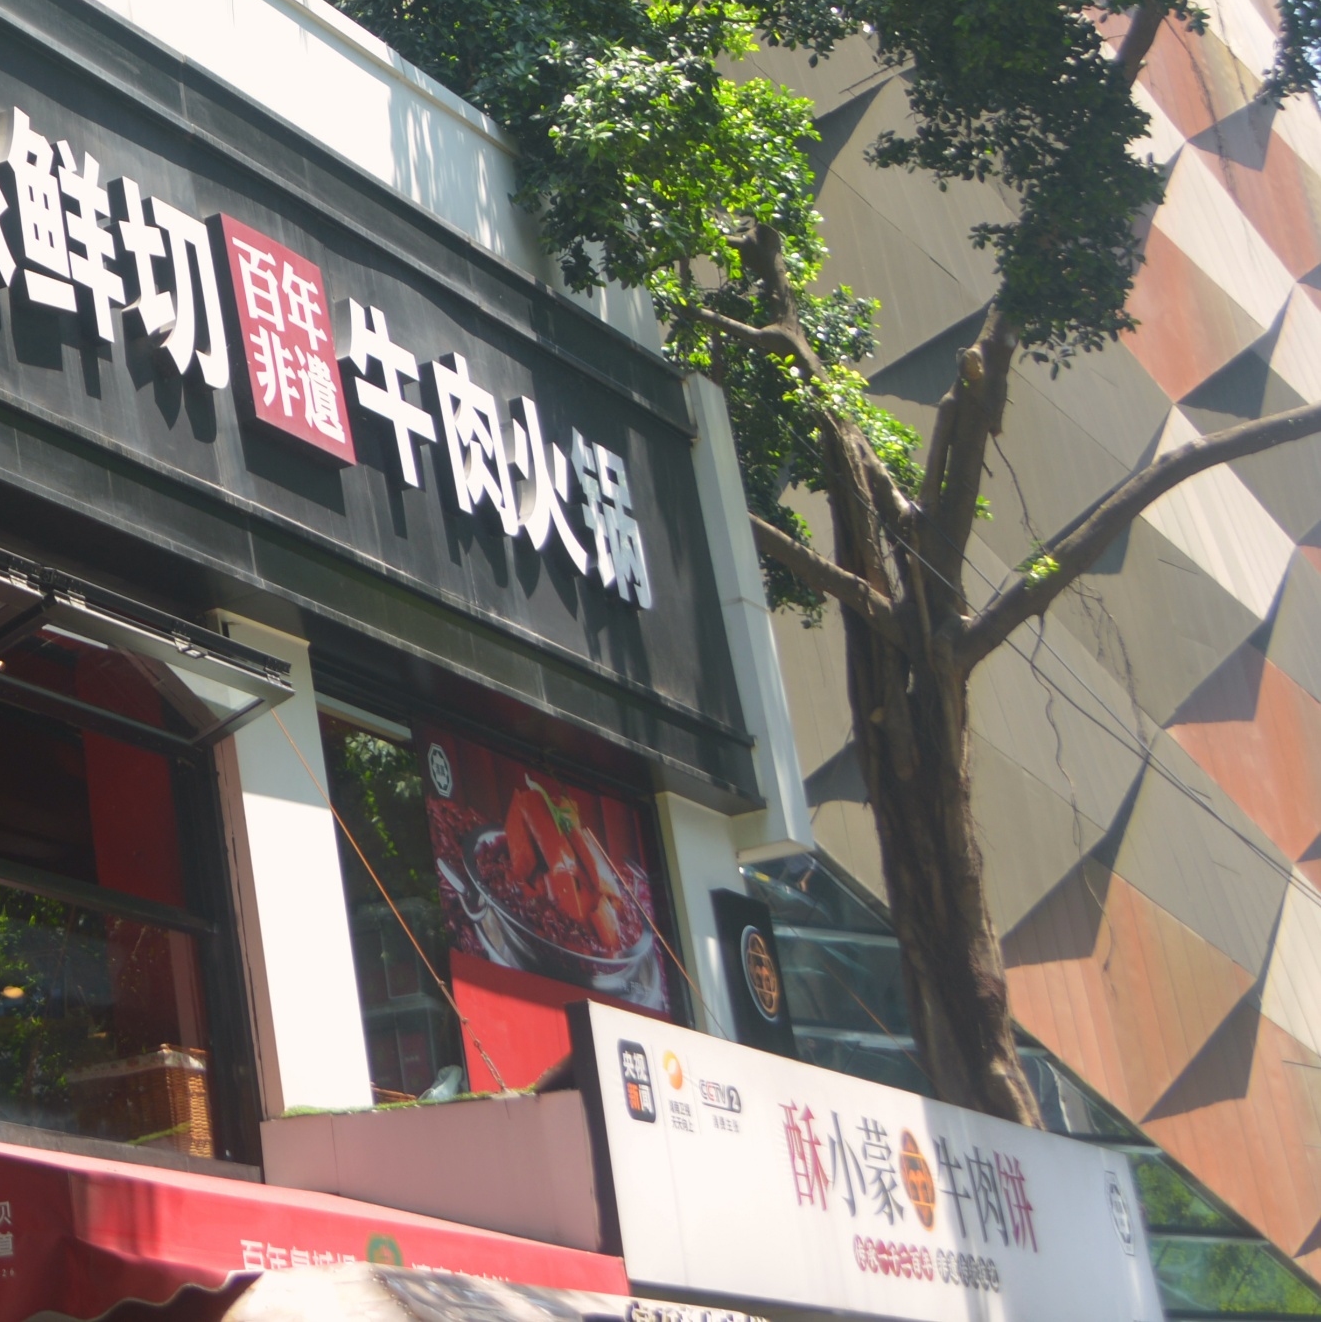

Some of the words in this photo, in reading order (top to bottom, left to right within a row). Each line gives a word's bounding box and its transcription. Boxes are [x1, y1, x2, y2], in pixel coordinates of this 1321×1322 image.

[232, 236, 328, 352] 百年
[348, 297, 653, 610] 牛肉火锅
[778, 1098, 904, 1227] 酥小蒙
[933, 1134, 1038, 1254] 牛肉饼
